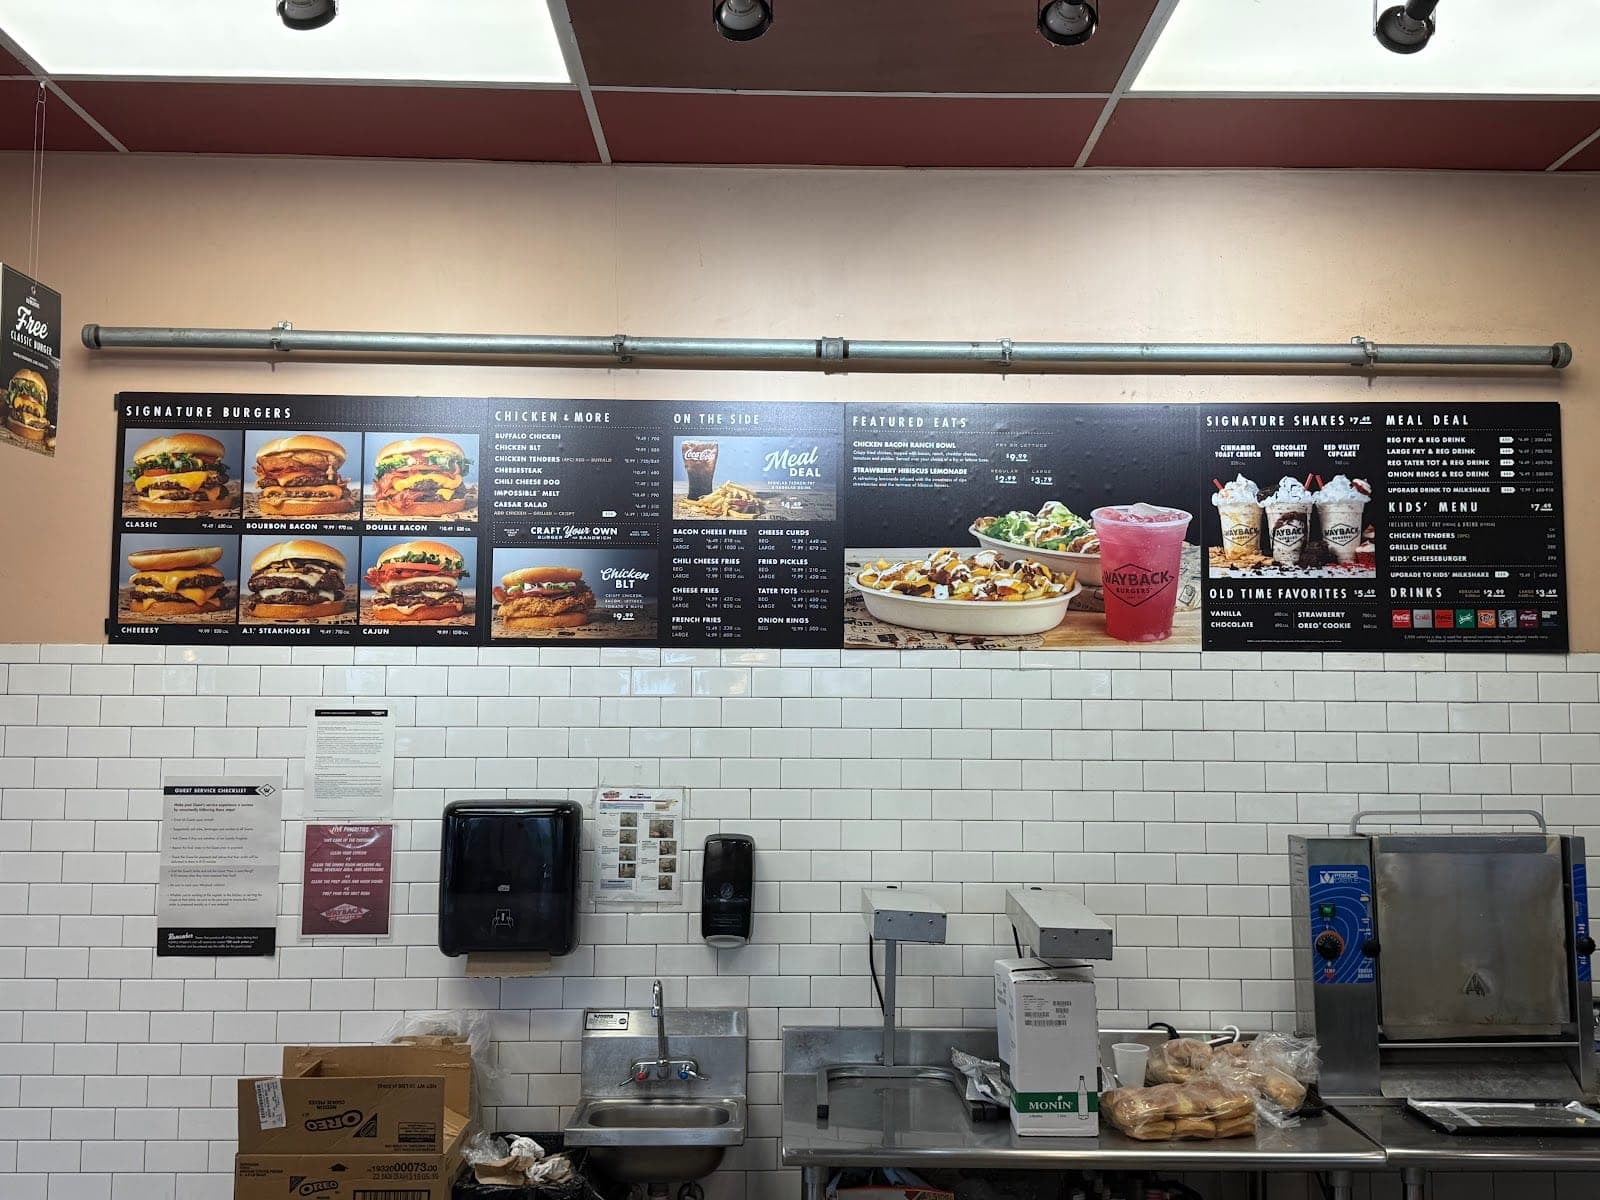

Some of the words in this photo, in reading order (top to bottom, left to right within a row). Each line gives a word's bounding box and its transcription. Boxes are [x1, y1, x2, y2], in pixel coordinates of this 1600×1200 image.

[16, 306, 48, 339] Free
[10, 330, 32, 348] CLASSIC
[34, 339, 53, 356] BURGER
[126, 405, 213, 417] SIGNATURE
[223, 407, 291, 418] BURGERS
[495, 411, 557, 422] CHICKEN
[564, 413, 569, 421] &
[574, 412, 610, 423] MORE
[673, 414, 691, 424] ON
[700, 414, 722, 424] THE
[730, 414, 759, 425] SIDE
[853, 416, 923, 427] FEATURED
[934, 417, 967, 428] EATS
[1207, 415, 1285, 426] SIGNATURE
[1294, 415, 1344, 426] SHAKES
[1386, 415, 1423, 425] MEAL
[1433, 415, 1469, 425] DEAL
[763, 446, 818, 472] Meal
[789, 468, 821, 477] DEAL
[1438, 502, 1478, 512] MENU
[530, 527, 560, 535] CRAFT
[563, 525, 590, 538] Your
[600, 567, 650, 581] Chicken
[1103, 570, 1169, 586] WAYBACK
[615, 580, 635, 589] BLT
[1209, 588, 1233, 599] OLD
[1241, 589, 1272, 599] TIME
[1278, 589, 1347, 599] FAVORITES
[1390, 587, 1442, 598] DRINKS
[1029, 1095, 1071, 1110] MONIN
[305, 1110, 363, 1132] OREO
[300, 1180, 338, 1196] OREO
